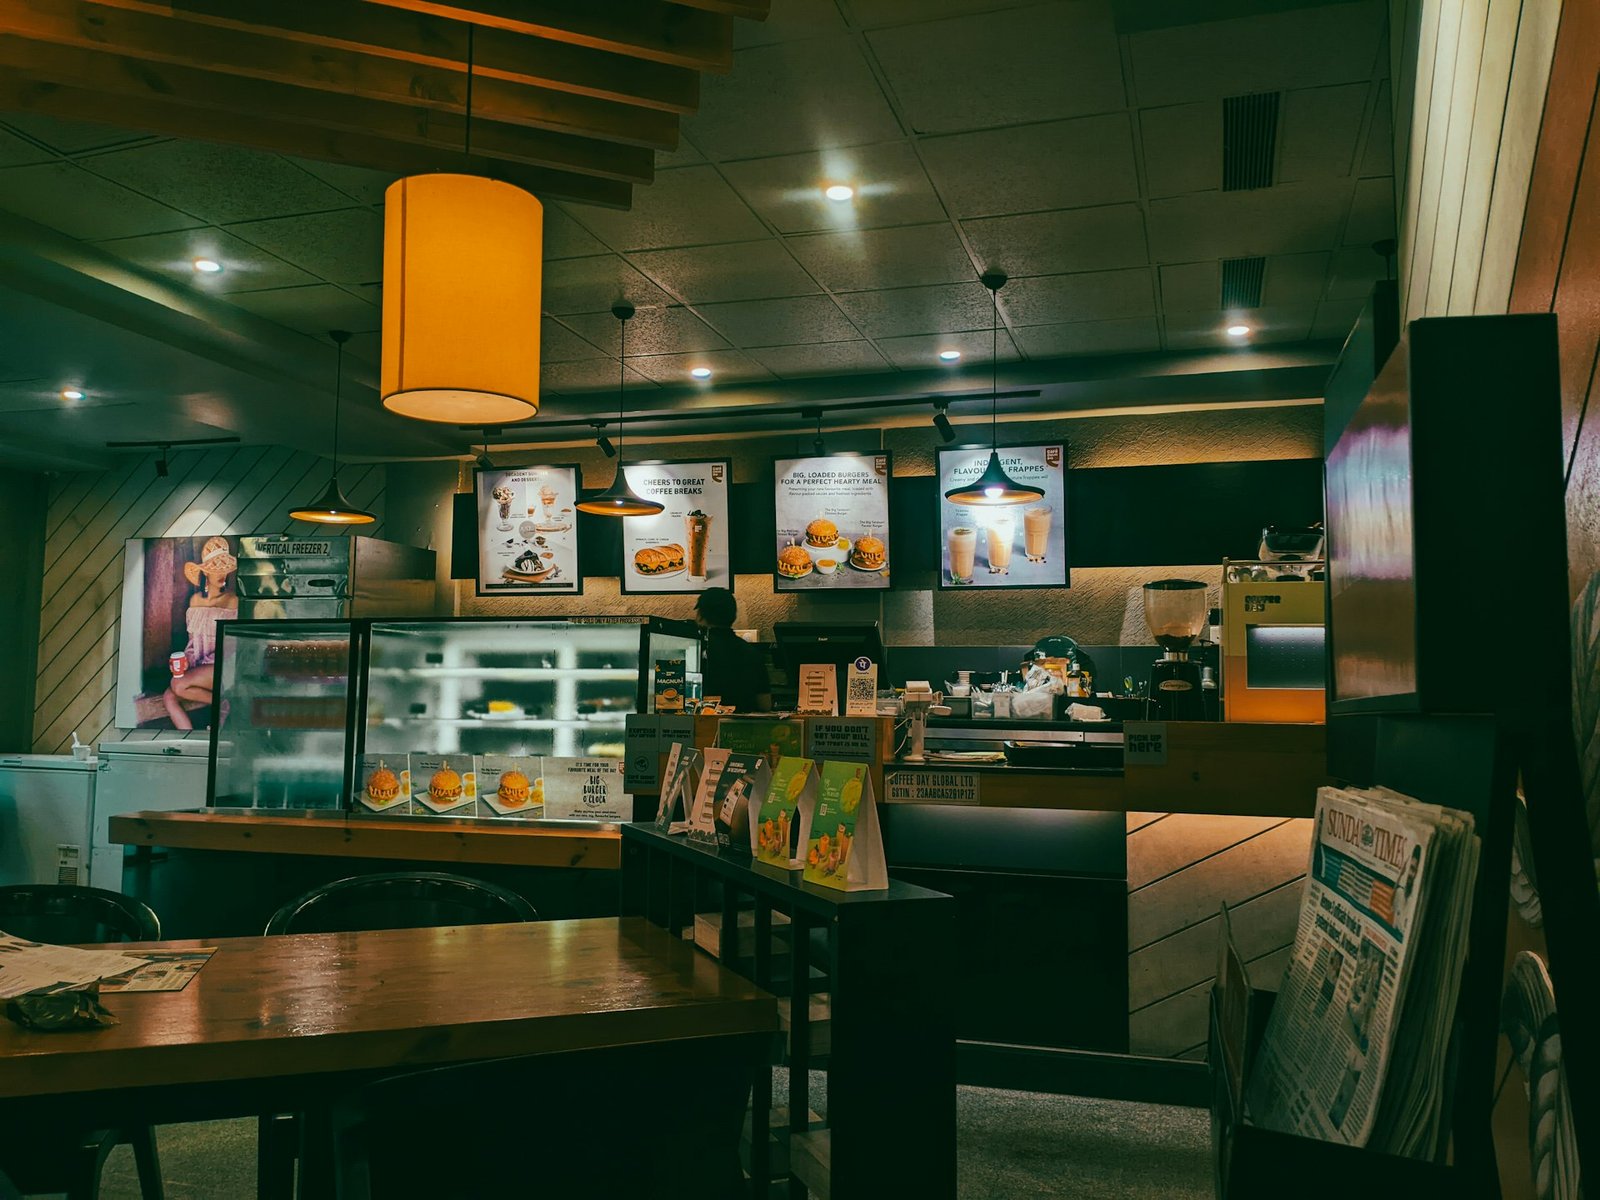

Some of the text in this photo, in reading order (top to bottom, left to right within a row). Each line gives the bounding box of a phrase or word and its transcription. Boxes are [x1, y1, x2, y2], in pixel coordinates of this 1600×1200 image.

[256, 543, 328, 554] VERTICAL FREEZER 2
[1129, 742, 1162, 752] here
[590, 775, 600, 784] BIG
[916, 774, 929, 785] DAY
[932, 775, 958, 786] GLOBAL
[960, 775, 976, 787] LTD.
[584, 785, 606, 794] BURGER
[1374, 827, 1408, 870] TIMES
